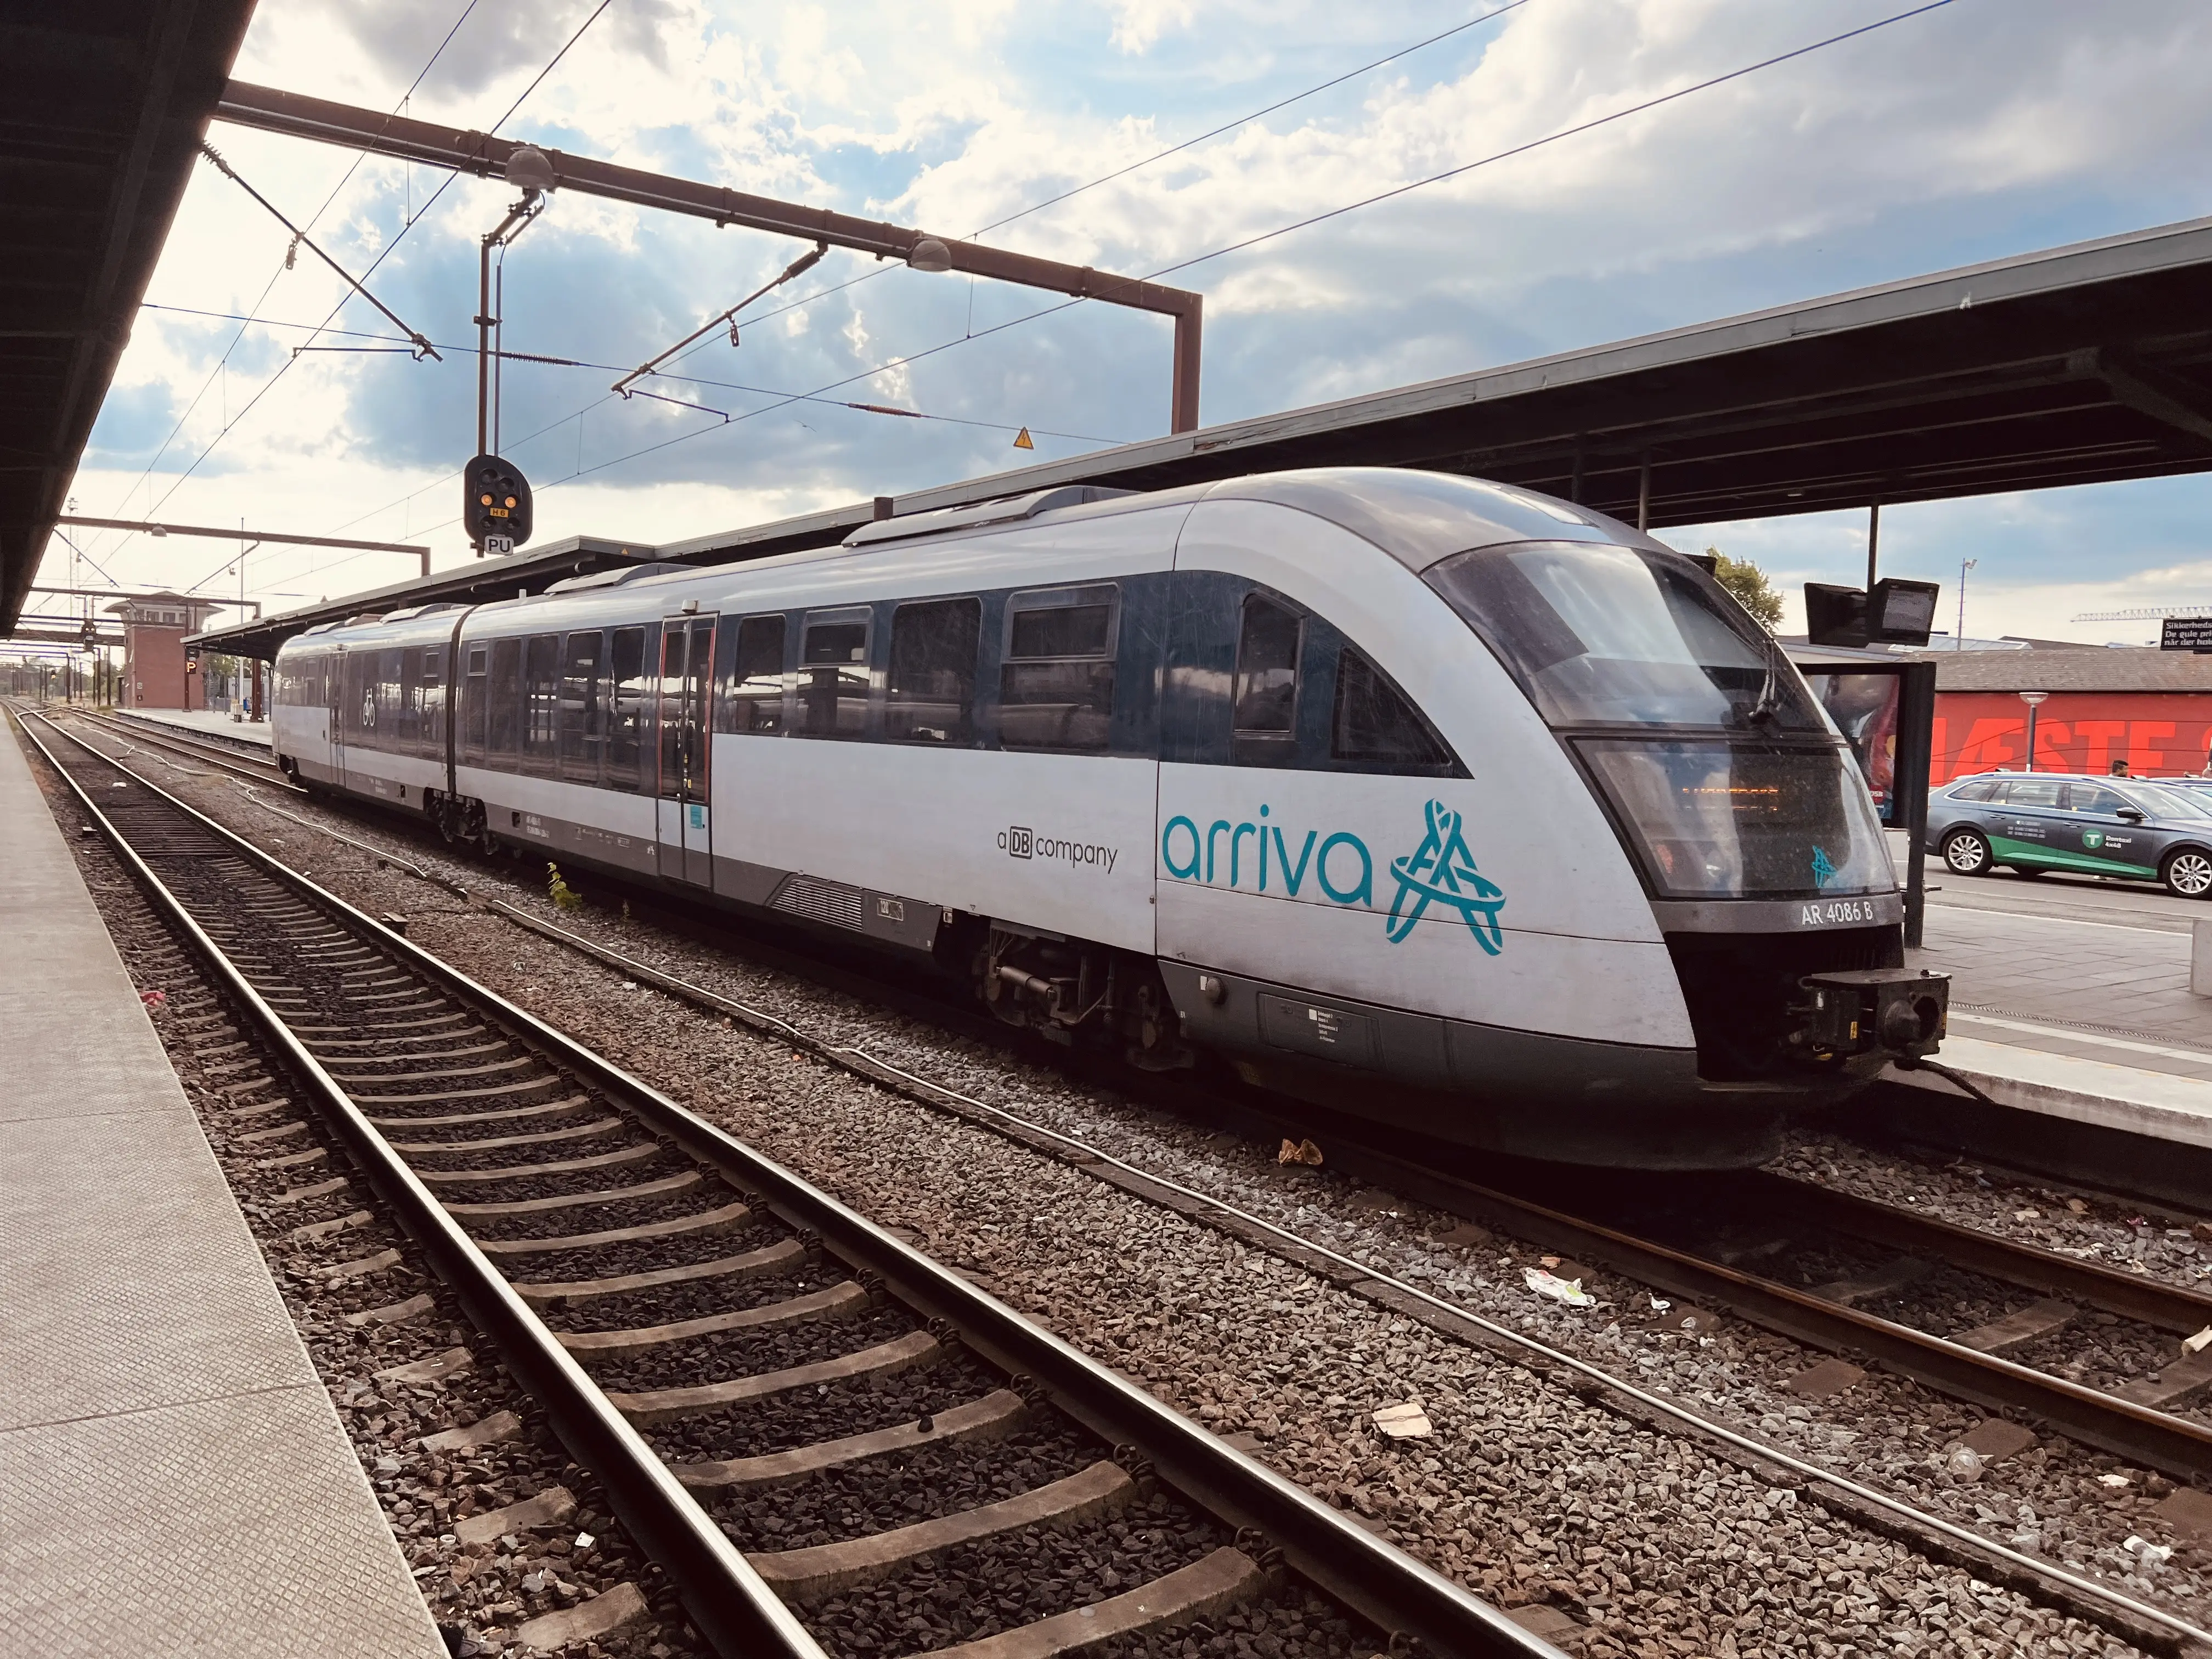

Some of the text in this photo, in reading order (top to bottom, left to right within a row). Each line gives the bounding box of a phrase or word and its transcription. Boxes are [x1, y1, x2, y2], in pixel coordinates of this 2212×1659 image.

[488, 539, 511, 553] PU
[187, 662, 196, 673] P
[997, 831, 1118, 874] a DB company
[1162, 804, 1373, 908] arriva
[1802, 901, 1873, 926] AR 4086 B
